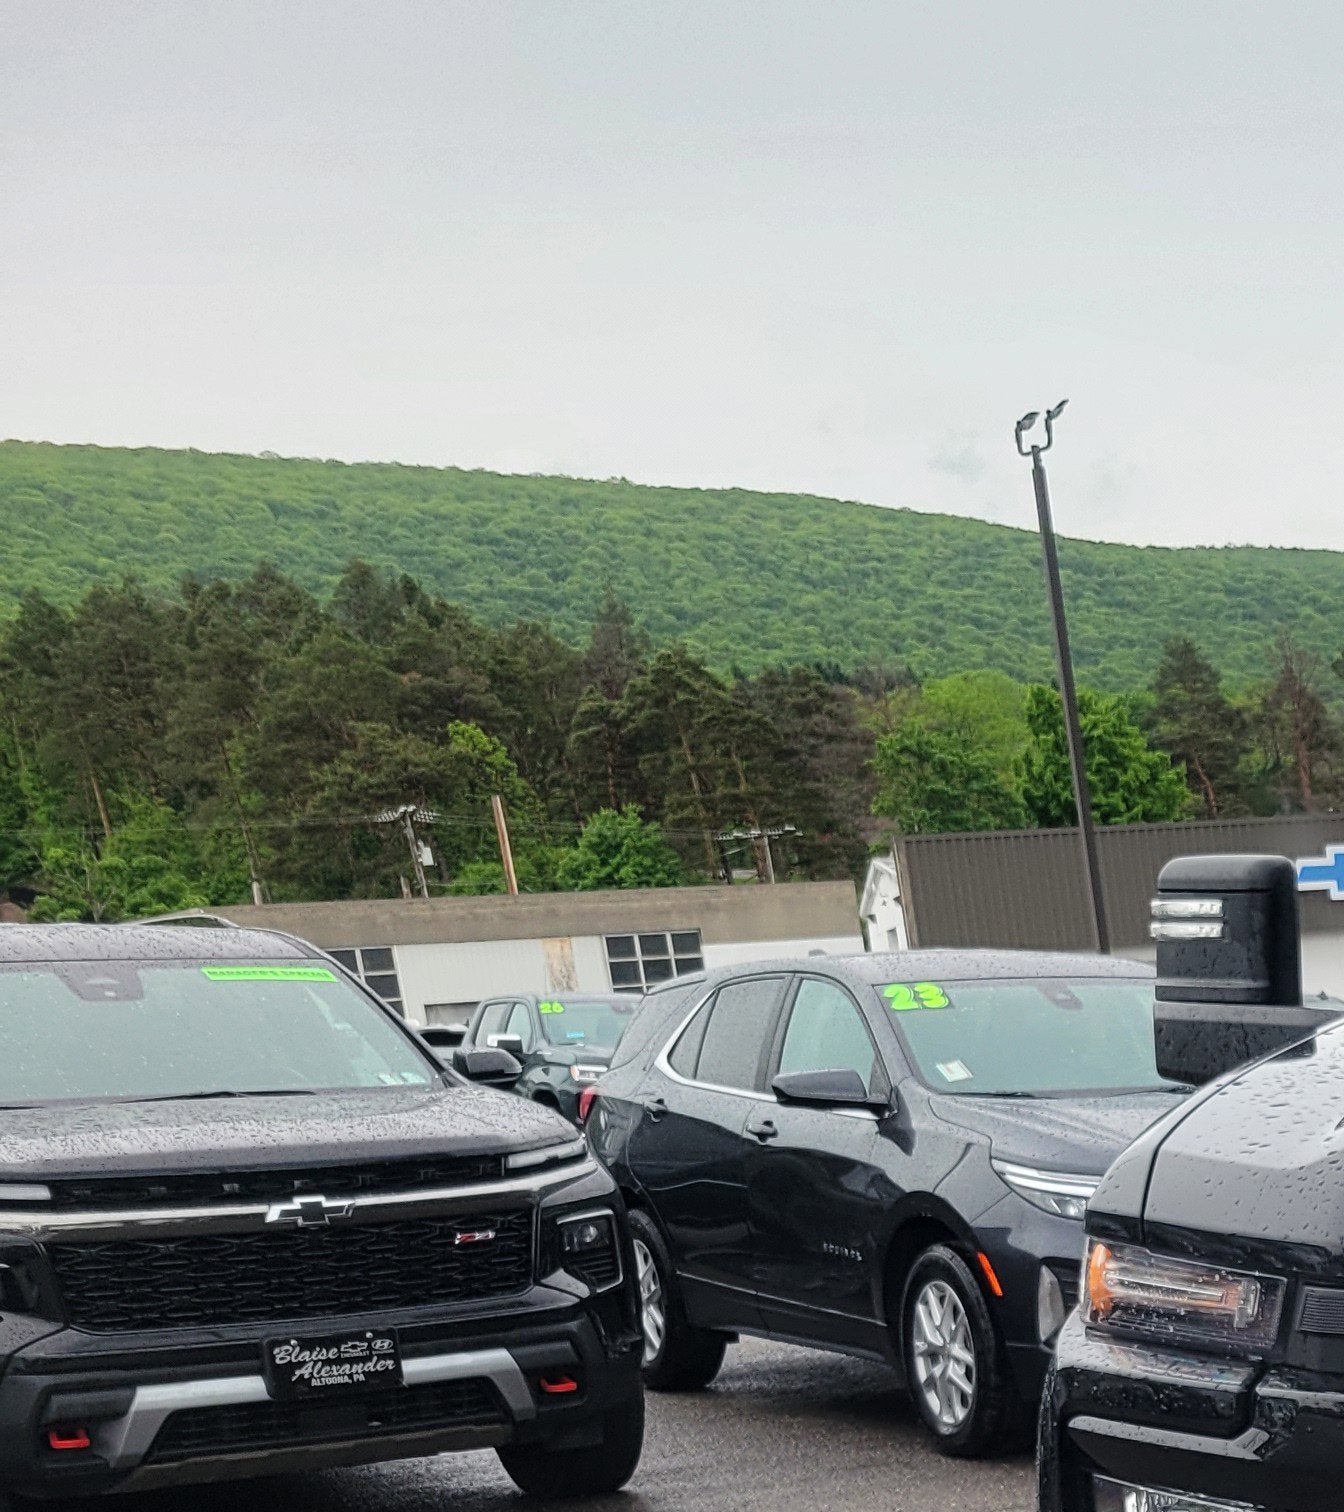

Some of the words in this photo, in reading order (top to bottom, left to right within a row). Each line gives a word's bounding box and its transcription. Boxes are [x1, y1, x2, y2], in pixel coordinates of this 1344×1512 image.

[883, 983, 949, 1010] 23
[273, 1345, 339, 1364] Blaise
[292, 1355, 395, 1381] Alexander
[353, 1373, 365, 1382] PA
